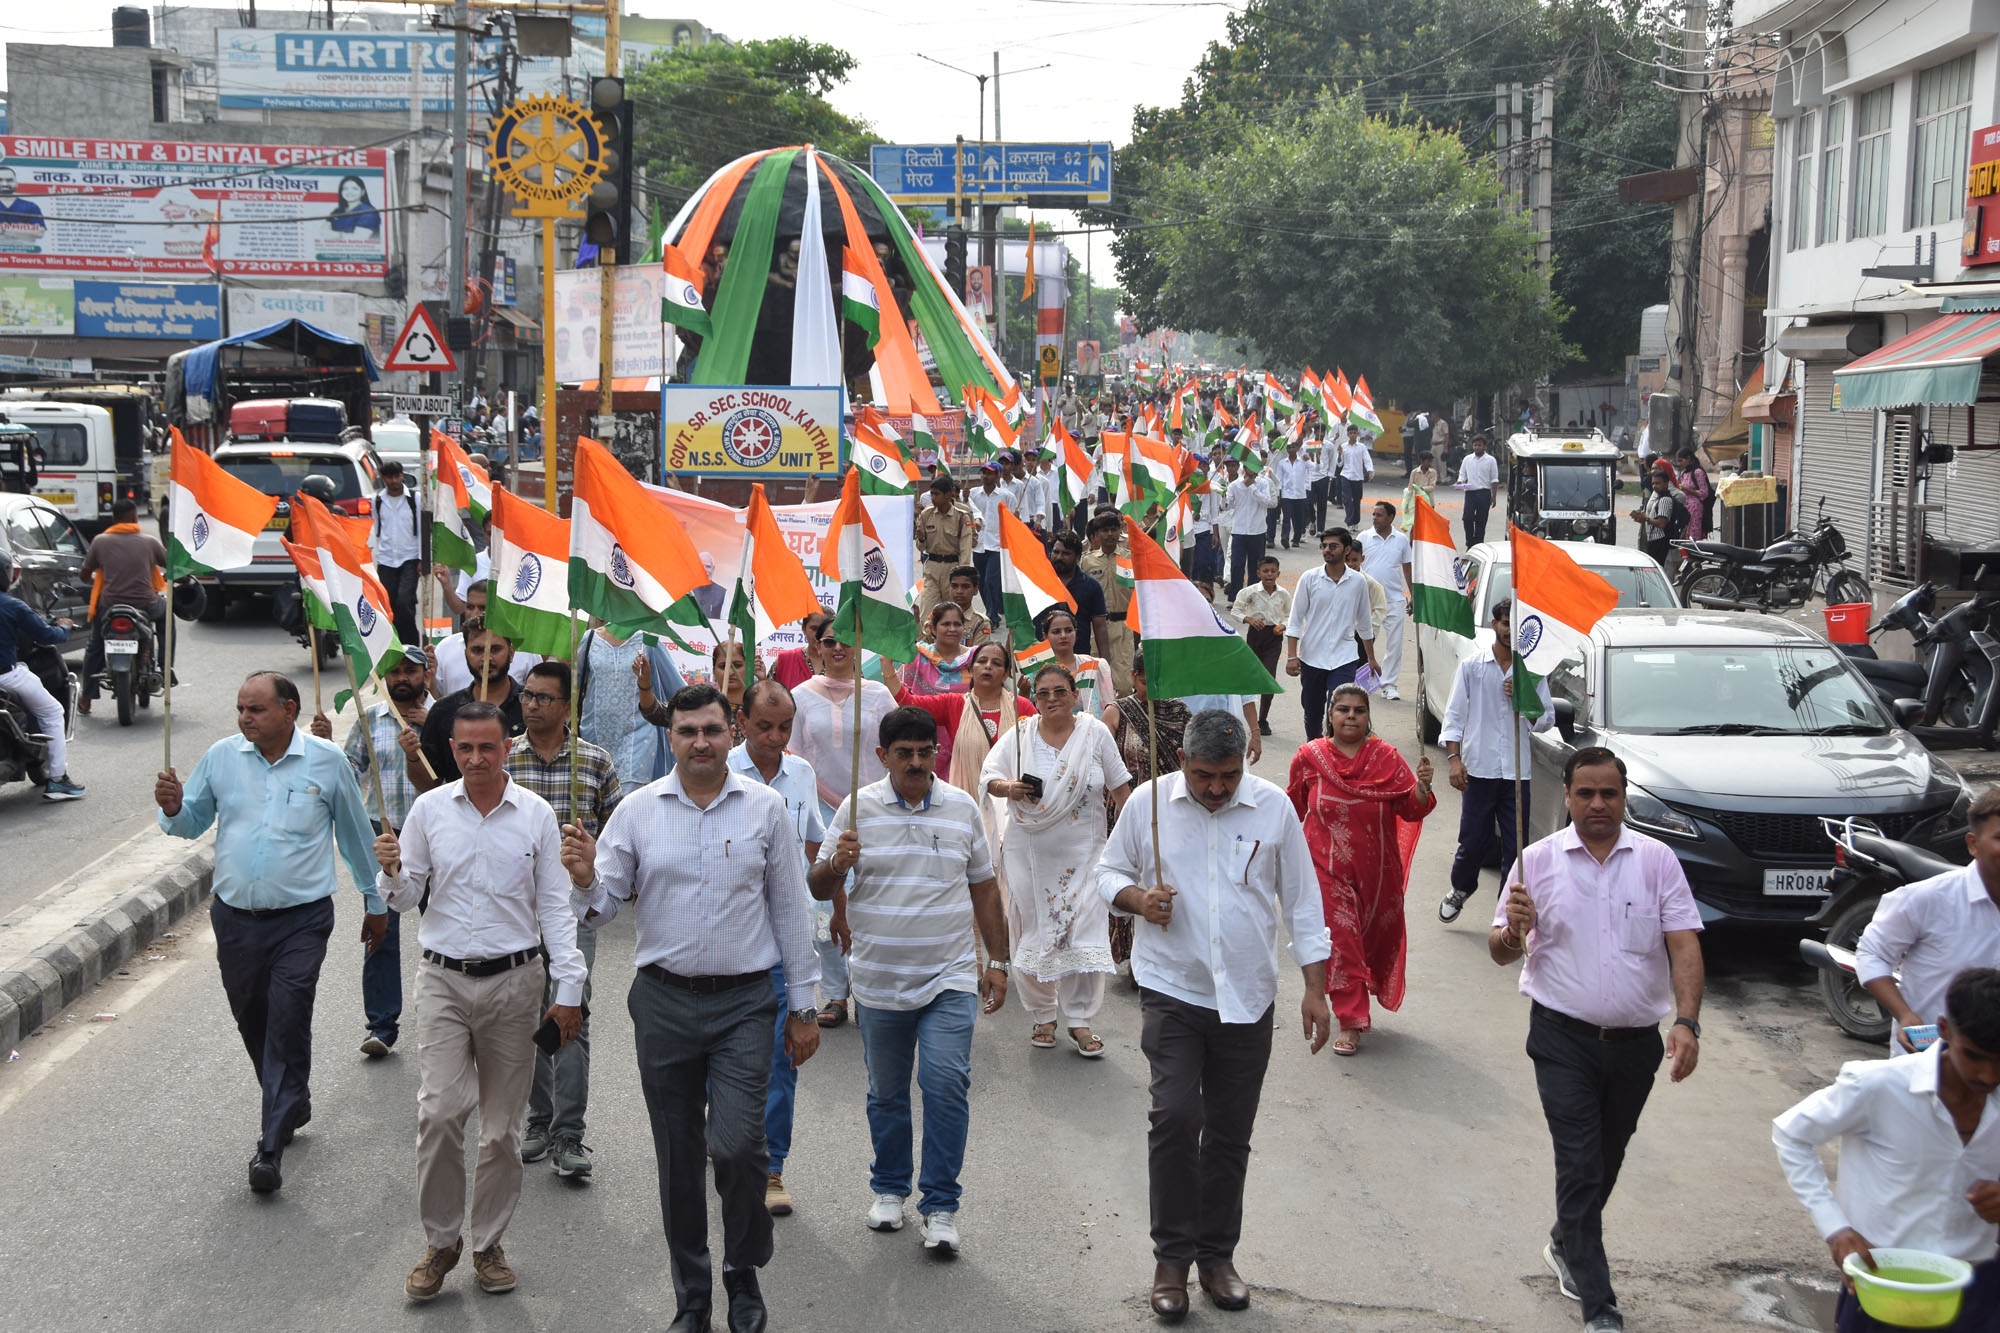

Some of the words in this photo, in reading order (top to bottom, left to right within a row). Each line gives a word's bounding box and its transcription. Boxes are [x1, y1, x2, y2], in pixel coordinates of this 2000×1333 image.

[262, 97, 301, 108] Pehowa
[521, 100, 576, 117] ROTARY
[14, 139, 88, 158] SMILE
[95, 141, 143, 161] ENT
[150, 144, 168, 161] &
[175, 145, 268, 164] DENTAL
[274, 148, 368, 167] CENTRE
[904, 147, 943, 167] दिल्ली
[1008, 152, 1056, 166] करनाल
[1064, 151, 1082, 166] 62
[33, 171, 77, 184] नाक,
[82, 173, 125, 186] कान,
[130, 174, 165, 186] गला
[257, 175, 319, 191] विशेषज्ञ
[503, 169, 591, 200] INTERNATIONAL
[904, 168, 934, 188] मेरठ
[1064, 171, 1080, 183] 16
[11, 256, 46, 267] Towers,
[46, 258, 65, 267] Mini
[66, 260, 84, 268] Sec.
[86, 260, 111, 270] Road,
[158, 262, 184, 271] Court,
[237, 262, 383, 275] 72067-11130,32
[261, 297, 325, 313] दवाईयां
[396, 397, 422, 411] ROUND
[424, 399, 449, 412] ABOUT
[743, 408, 758, 418] सेवा
[669, 429, 695, 470] GOVT.
[688, 411, 712, 432] SR.
[709, 394, 741, 416] SEC.
[741, 391, 795, 421] SCHOOL,
[794, 408, 836, 471] KAITHAL
[688, 450, 727, 467] N.S.S.
[779, 452, 814, 468] UNIT
[723, 436, 743, 465] NATIONAL
[742, 456, 767, 467] SERVICE
[766, 436, 781, 461] SCHEME
[811, 515, 833, 525] Tirang
[788, 531, 816, 554] घर
[768, 631, 794, 643] अगस्त
